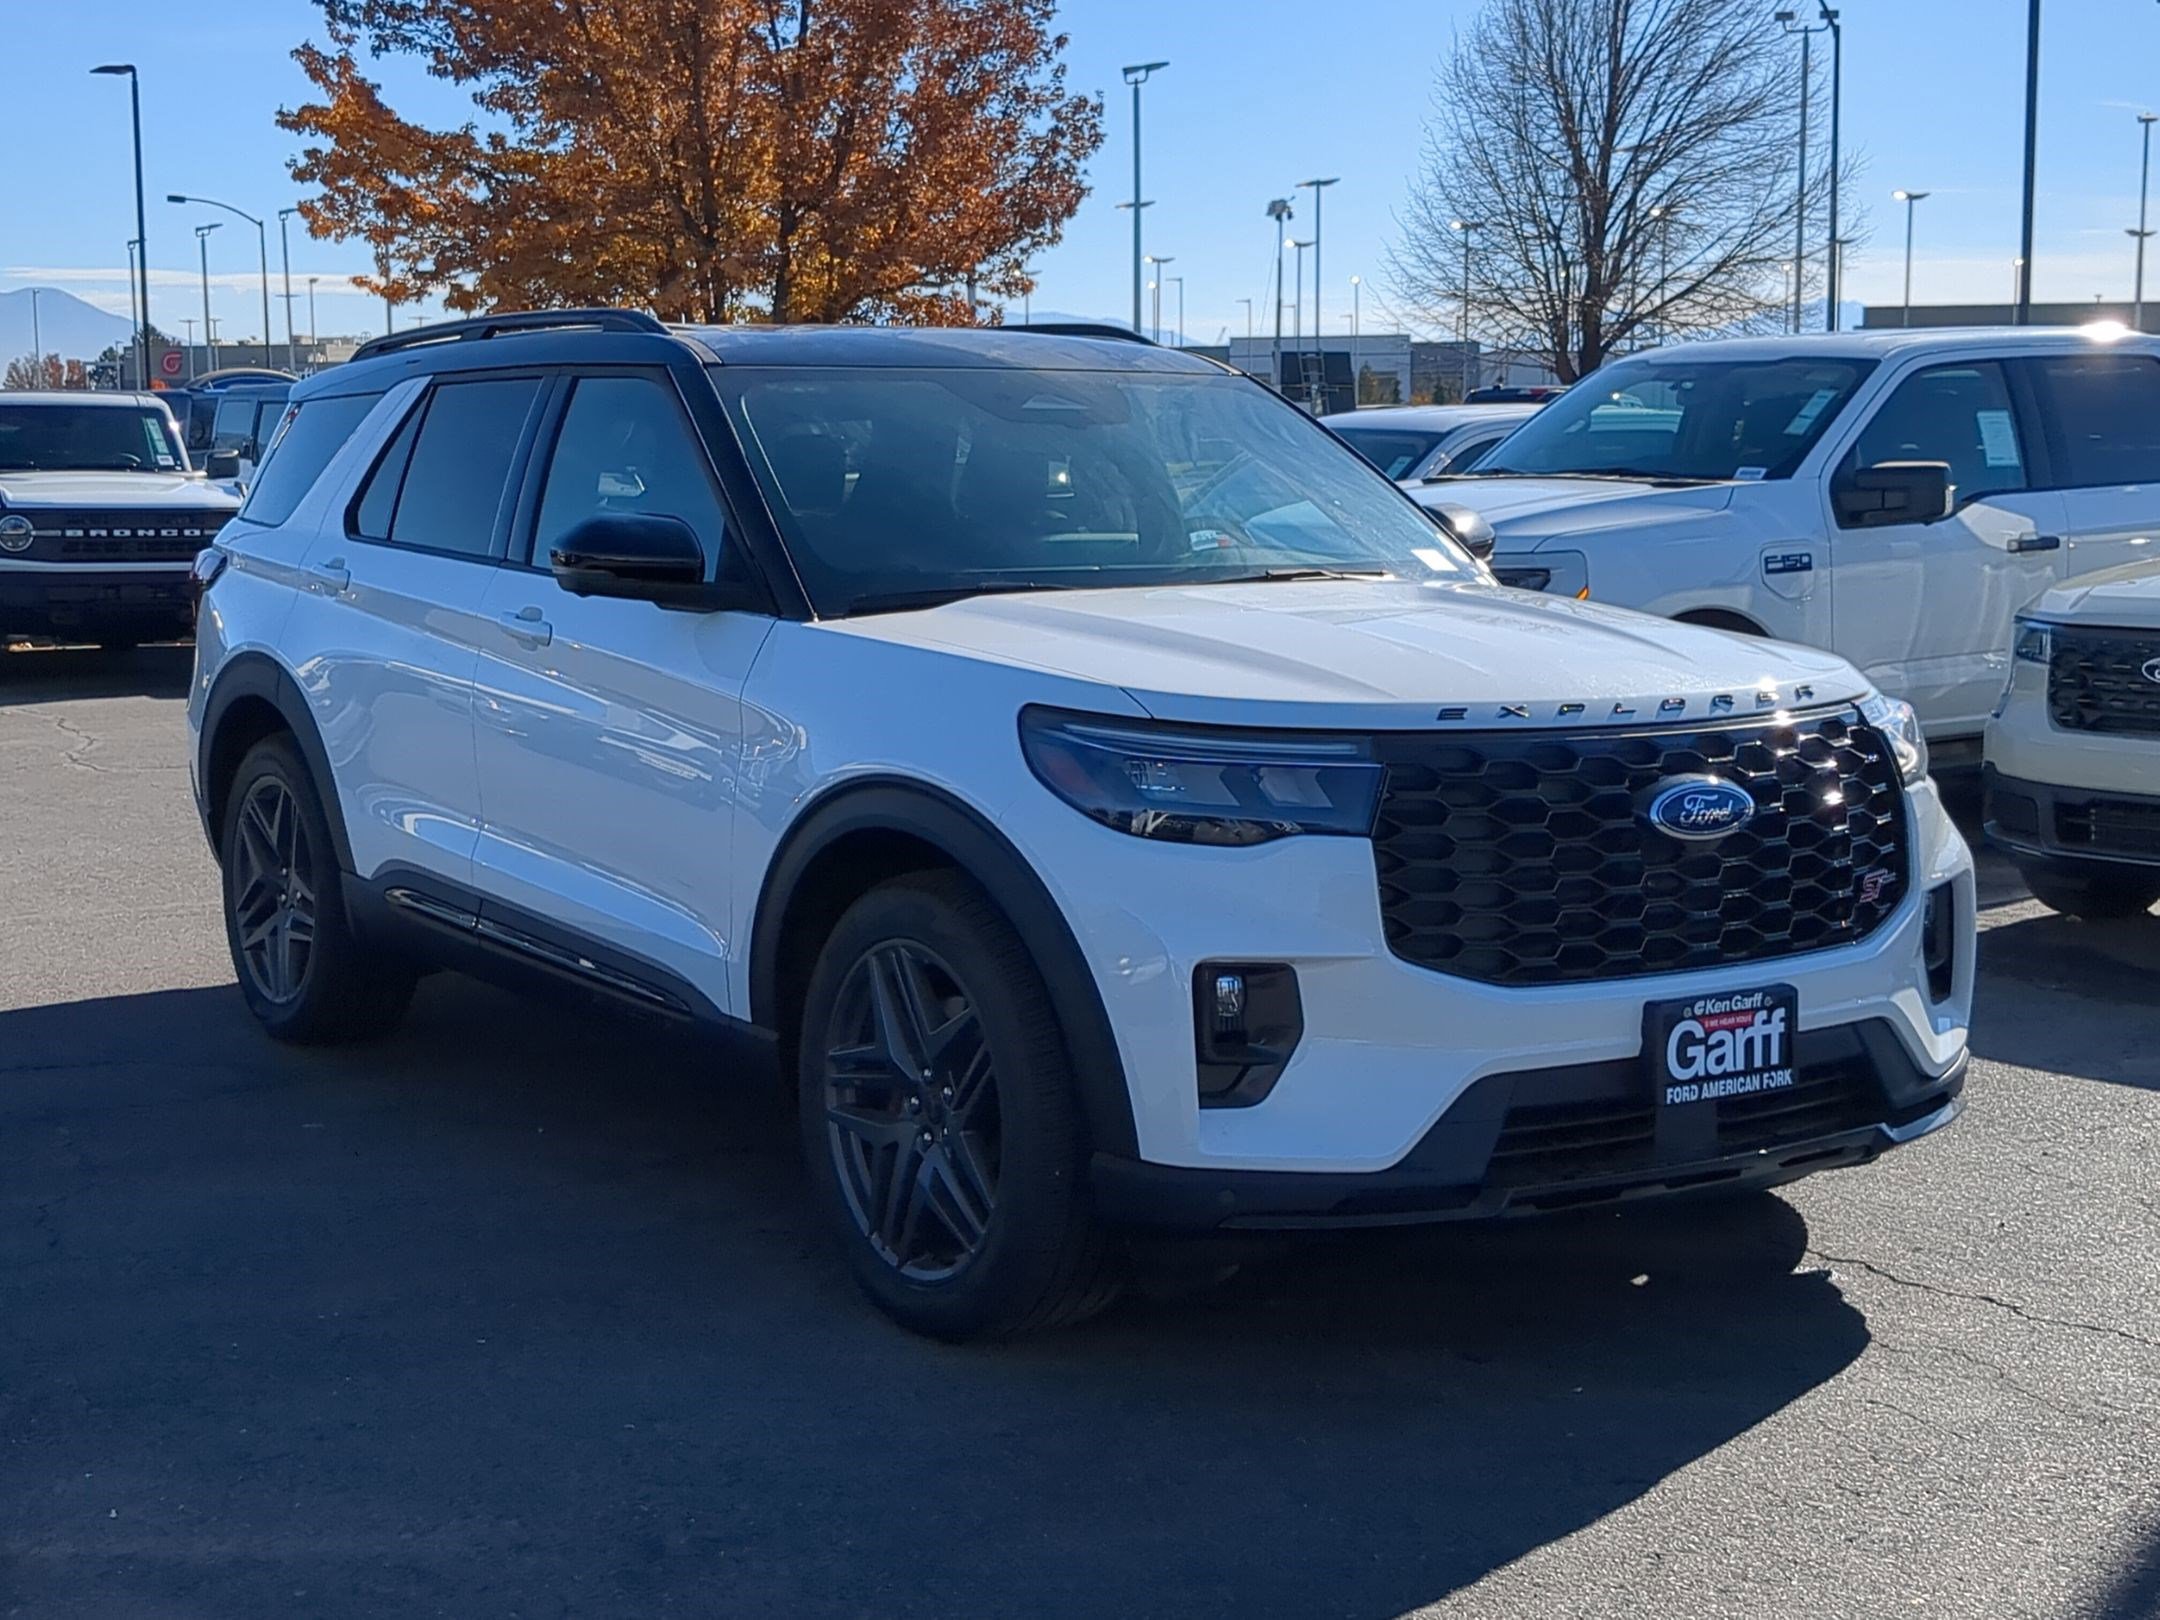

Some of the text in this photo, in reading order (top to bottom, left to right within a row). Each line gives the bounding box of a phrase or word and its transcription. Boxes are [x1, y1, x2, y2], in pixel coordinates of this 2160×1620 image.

[65, 529, 201, 537] BRONCO
[1436, 684, 1815, 721] EXPLORER
[1706, 998, 1730, 1015] Ken
[1731, 992, 1763, 1010] Garff
[1667, 1008, 1786, 1081] Garff
[1666, 1069, 1793, 1104] FORD AMERICAN FORK
